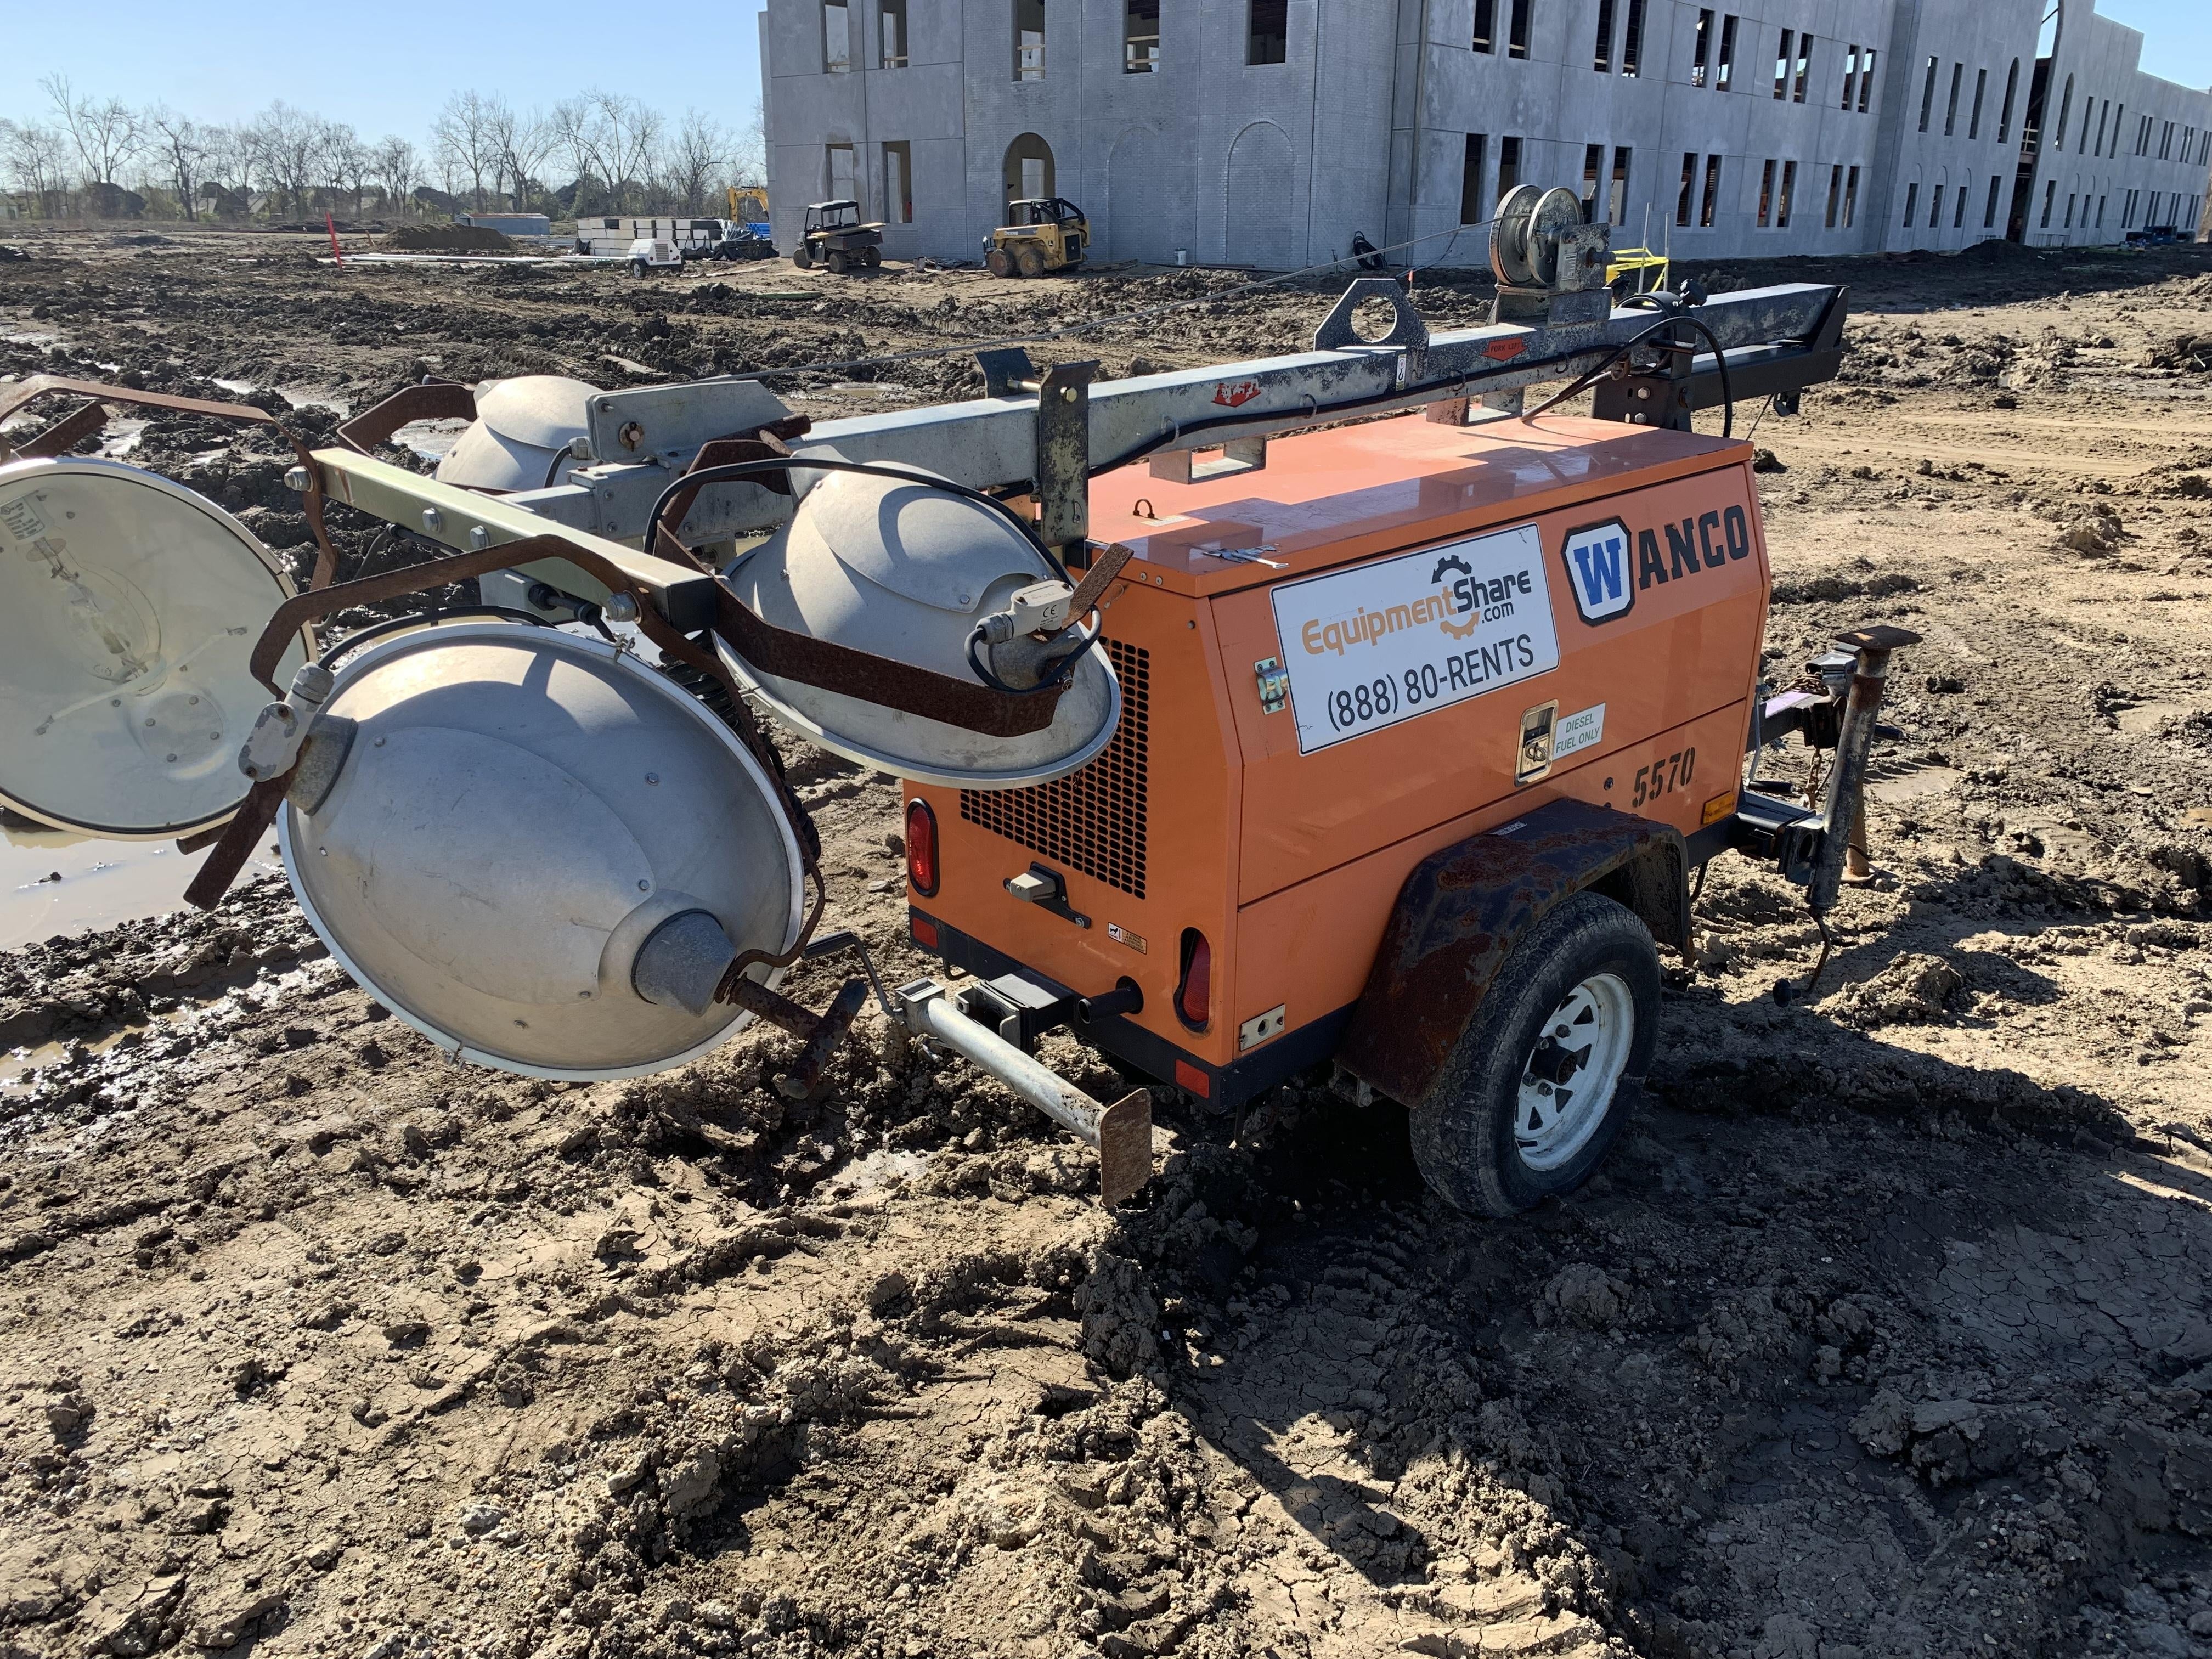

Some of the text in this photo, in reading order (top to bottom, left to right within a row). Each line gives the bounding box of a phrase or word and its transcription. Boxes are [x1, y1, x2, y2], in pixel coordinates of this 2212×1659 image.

[1573, 505, 1750, 606] WANCO
[1043, 605, 1057, 618] CE
[1302, 570, 1532, 656] EquipmentShare
[1482, 602, 1514, 624] .com
[1328, 634, 1534, 732] (888) 80-RENTS
[1556, 726, 1600, 754] FUEL ONLY
[1566, 713, 1594, 733] DIESEL
[1632, 747, 1695, 808] 5570
